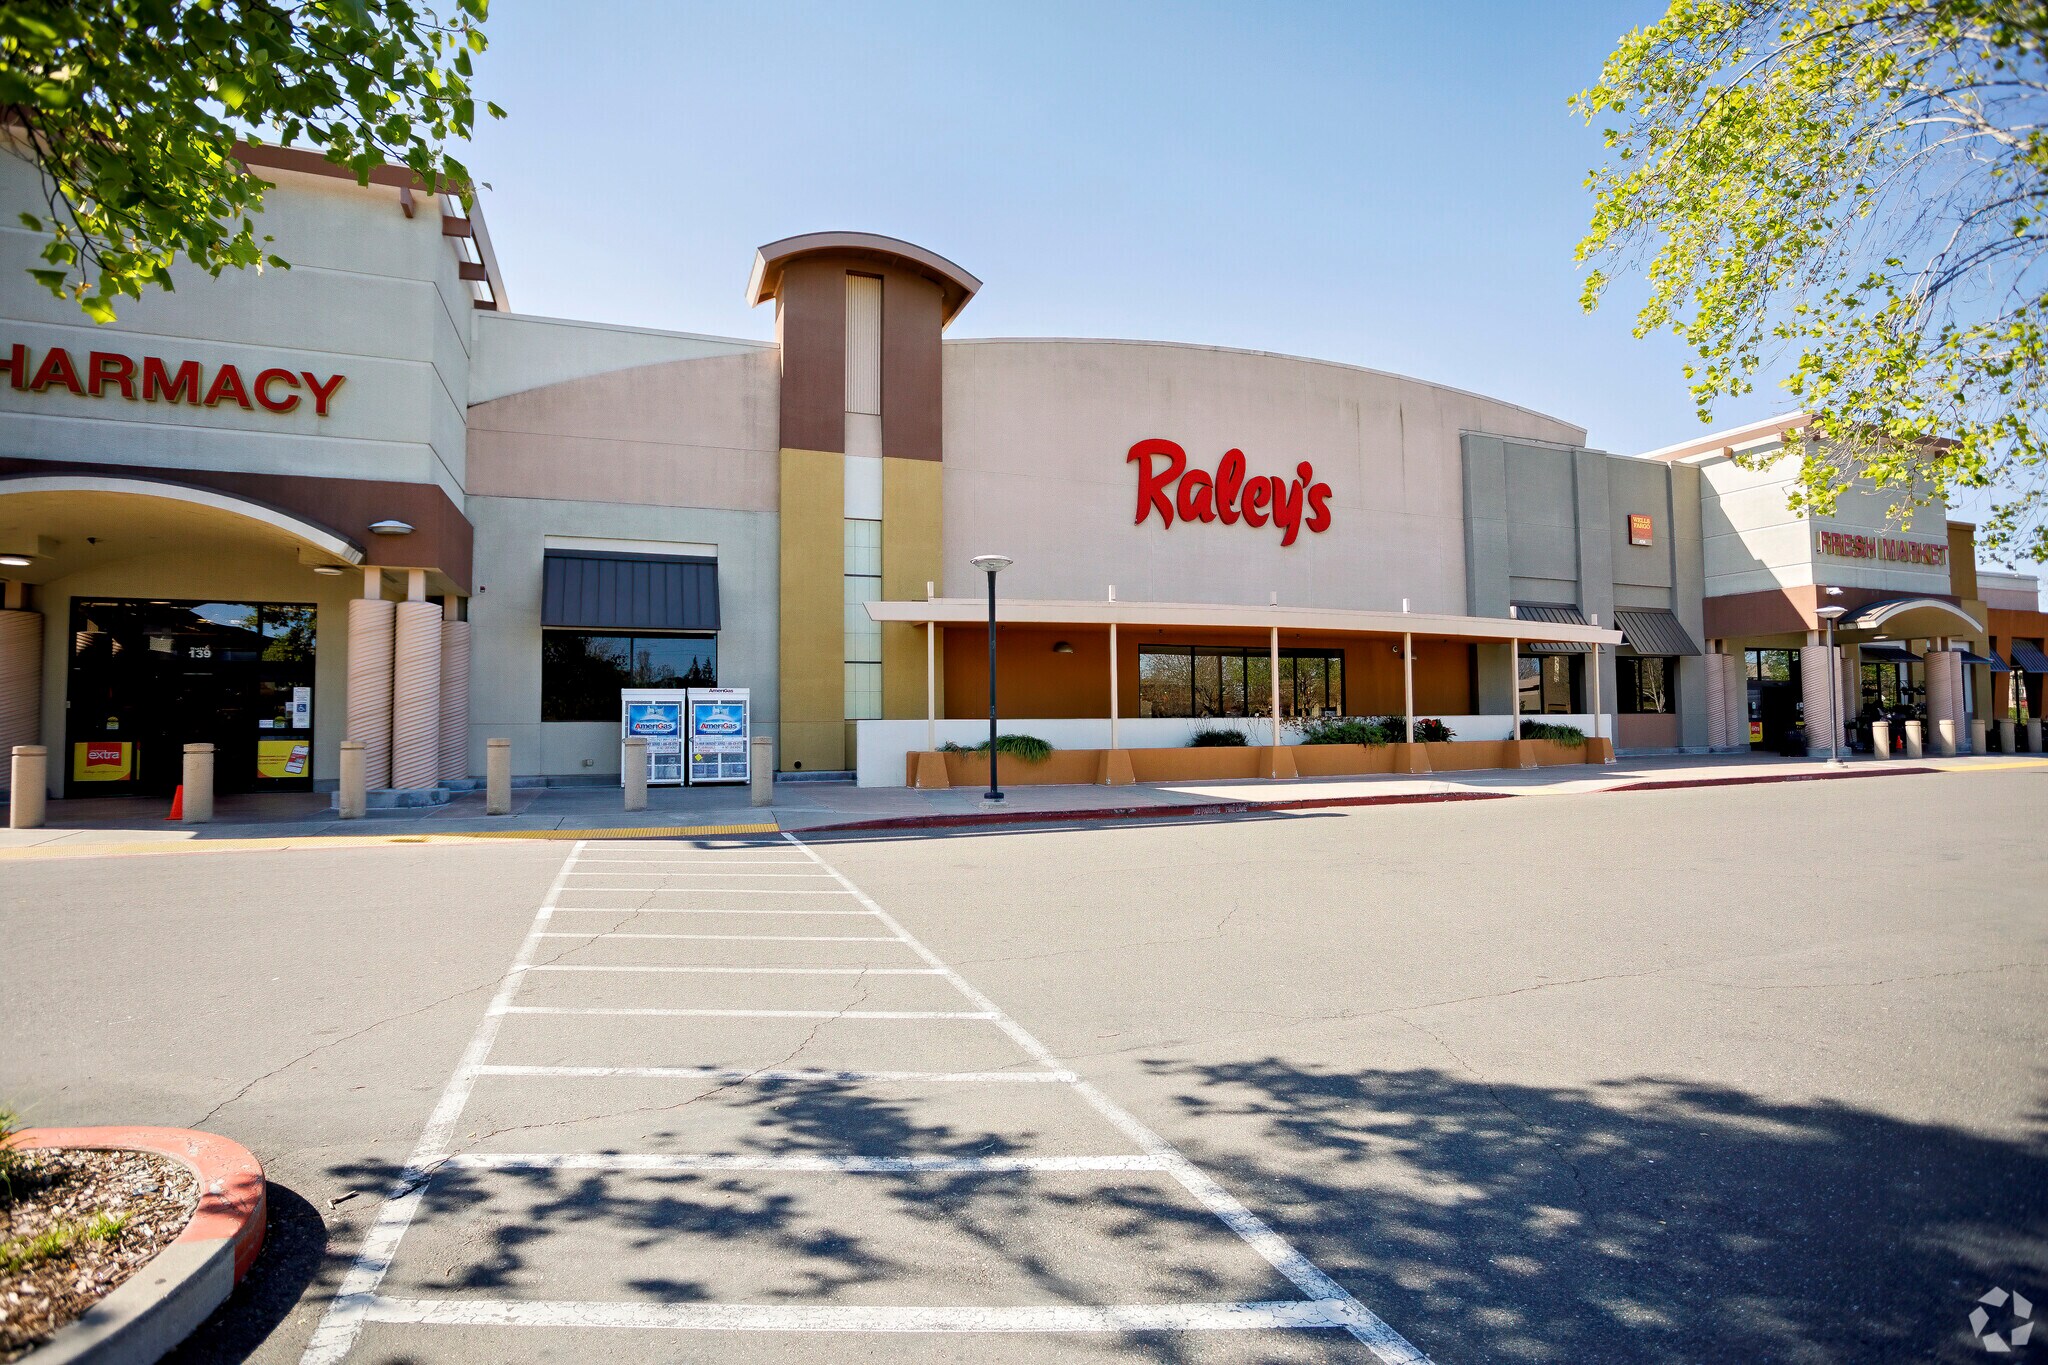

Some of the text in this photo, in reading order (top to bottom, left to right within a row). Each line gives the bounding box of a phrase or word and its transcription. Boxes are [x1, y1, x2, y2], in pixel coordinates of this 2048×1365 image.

[0, 343, 345, 416] HARMACY
[1126, 438, 1333, 546] Raley's
[1817, 530, 1948, 566] FRESH MARKET
[188, 649, 212, 659] 139
[635, 722, 673, 730] AmeriGas
[700, 722, 738, 730] AmeriGas
[88, 750, 120, 760] extra
